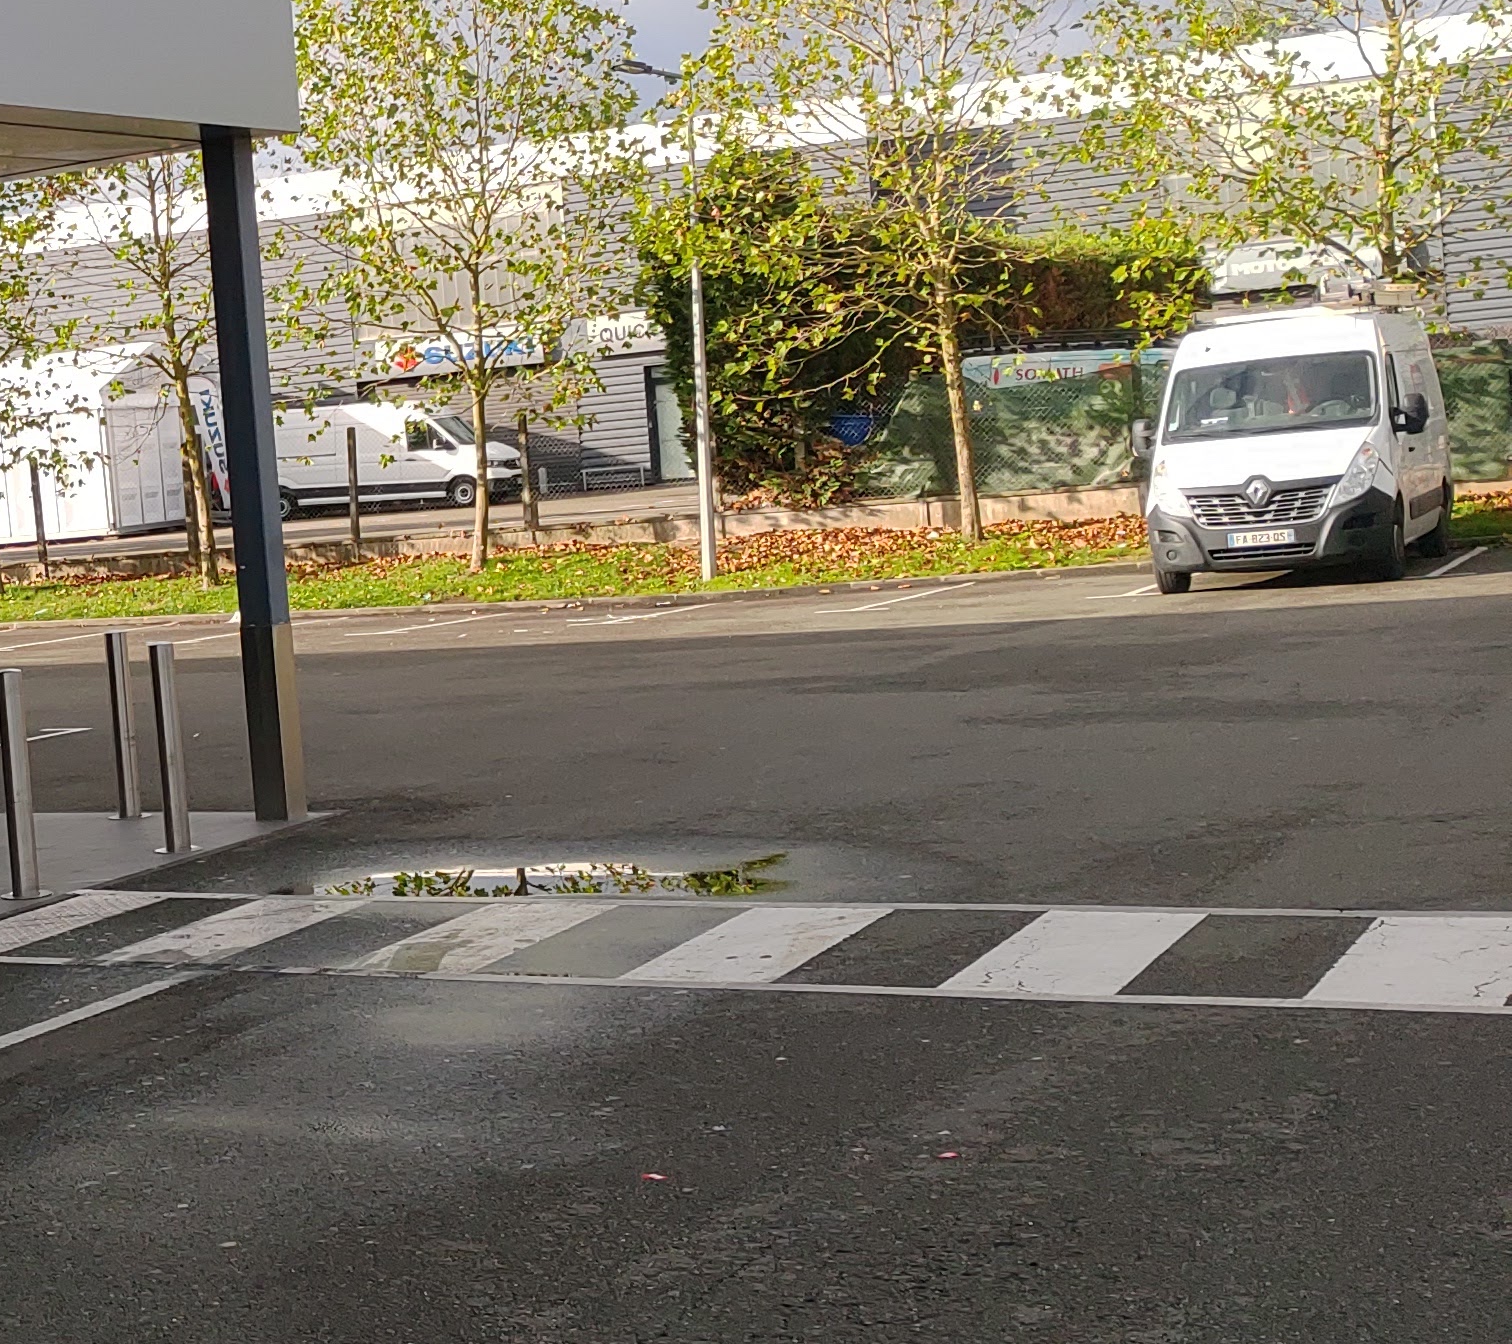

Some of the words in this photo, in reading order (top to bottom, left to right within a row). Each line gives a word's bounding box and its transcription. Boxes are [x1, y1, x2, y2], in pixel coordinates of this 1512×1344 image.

[599, 322, 656, 344] QUIC
[1016, 367, 1083, 381] SOATH
[199, 389, 227, 474] SUZUKI
